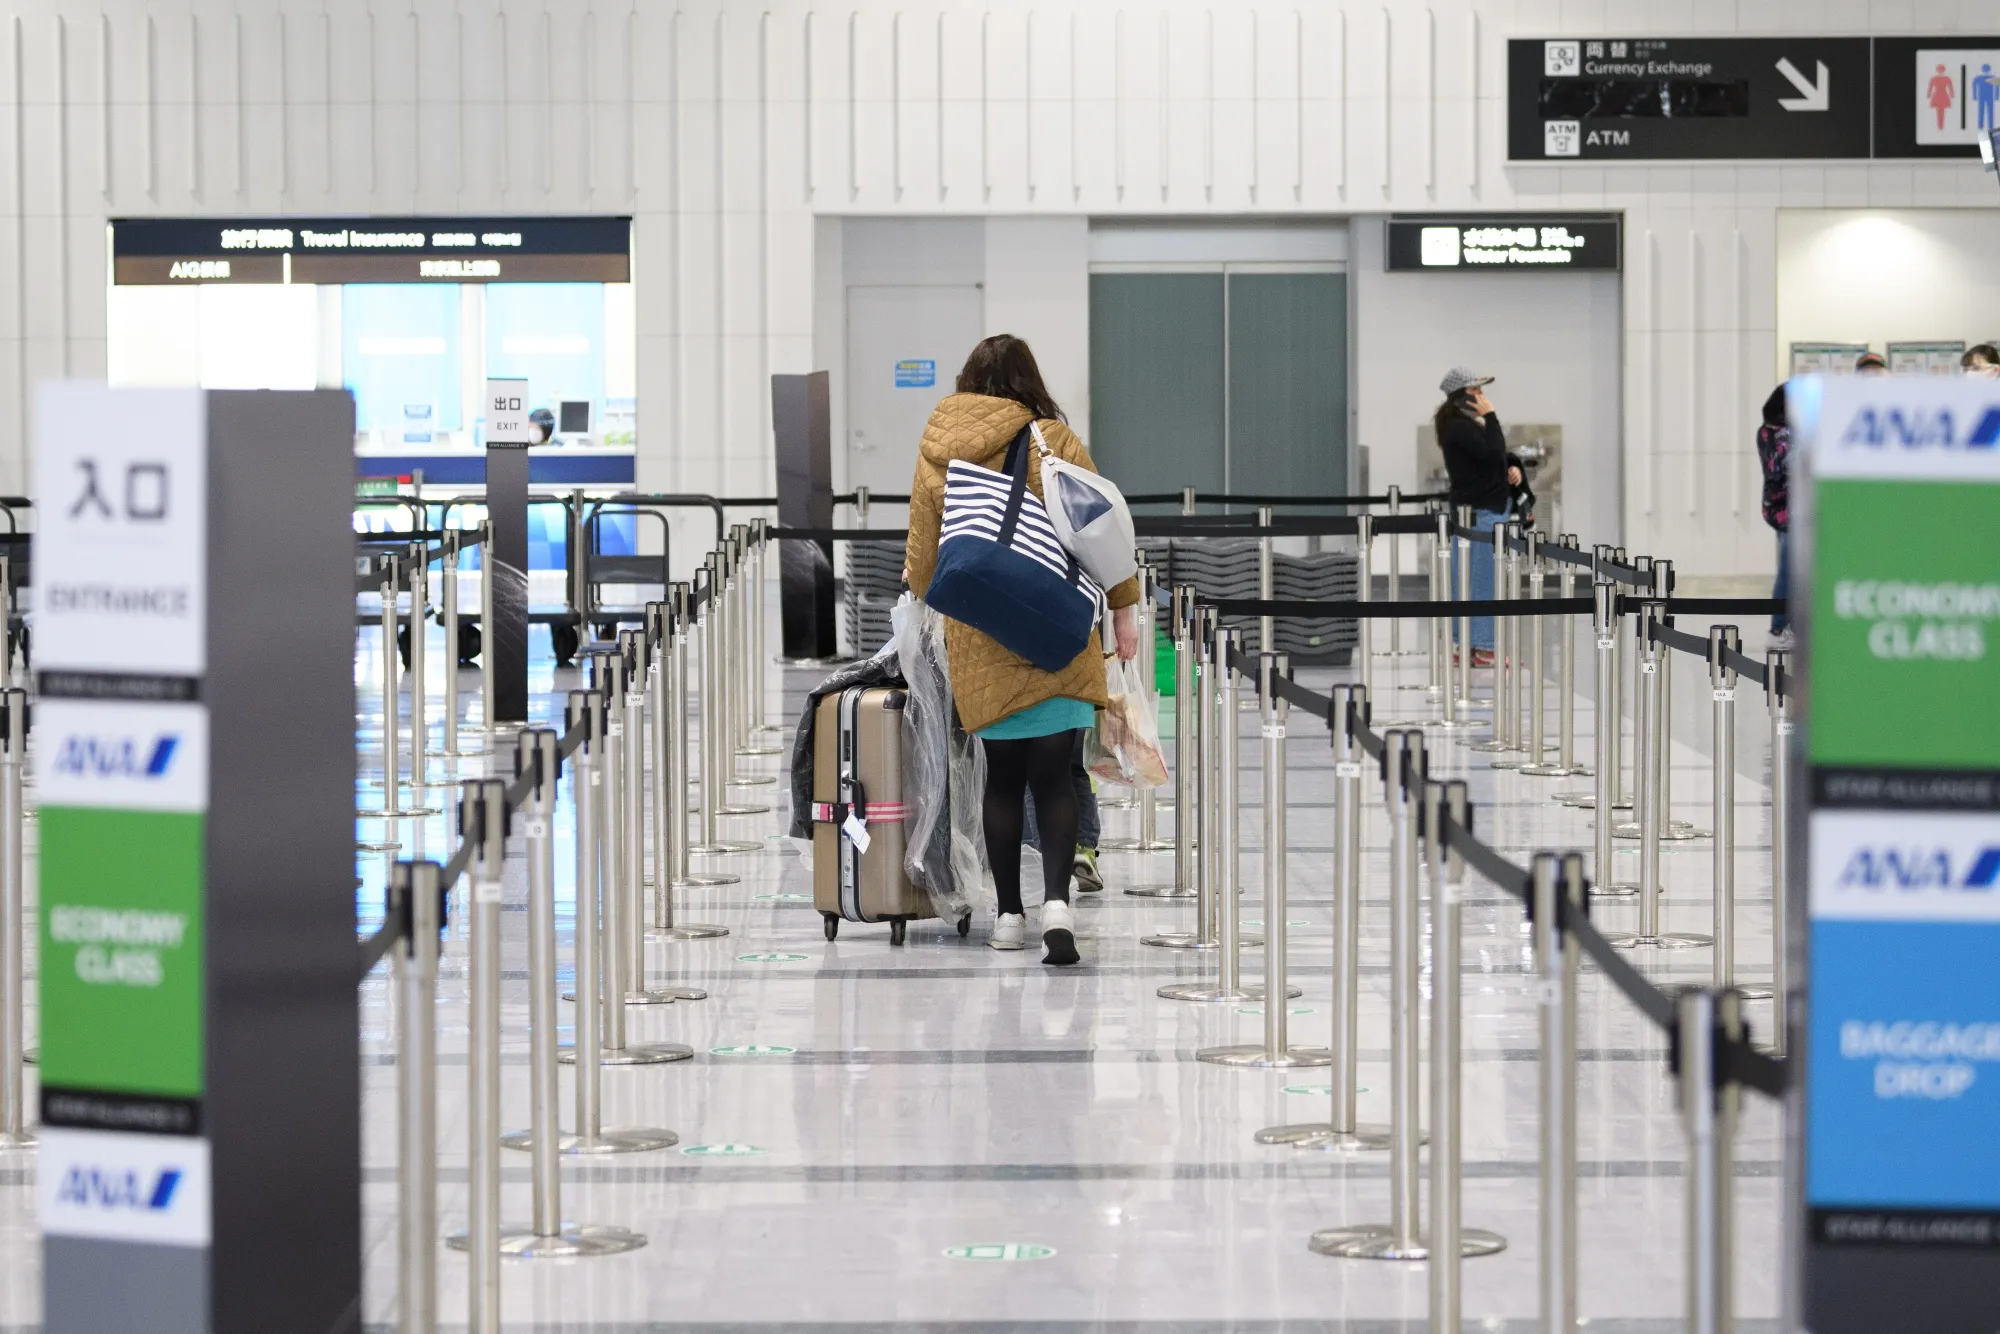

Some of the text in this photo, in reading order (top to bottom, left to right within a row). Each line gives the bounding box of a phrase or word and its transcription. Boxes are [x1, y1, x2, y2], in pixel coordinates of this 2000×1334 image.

[1585, 60, 1713, 77] Currency Exchange
[1548, 124, 1576, 134] ATM
[1586, 130, 1630, 145] ATM
[300, 230, 348, 247] Travel
[350, 231, 425, 247] Insurance
[494, 396, 521, 411] 出口
[496, 422, 519, 431] EXIT
[1843, 404, 1957, 449] ANA
[68, 457, 171, 522] 入口
[47, 583, 189, 616] ENTRANCE
[1868, 620, 1986, 661] CLASS
[54, 736, 138, 778] ANA
[1838, 848, 1952, 890] ANA
[50, 905, 185, 946] ECONOMY
[75, 946, 163, 987] CLASS
[1873, 1062, 1977, 1099] DROP
[58, 1164, 144, 1208] ANA
